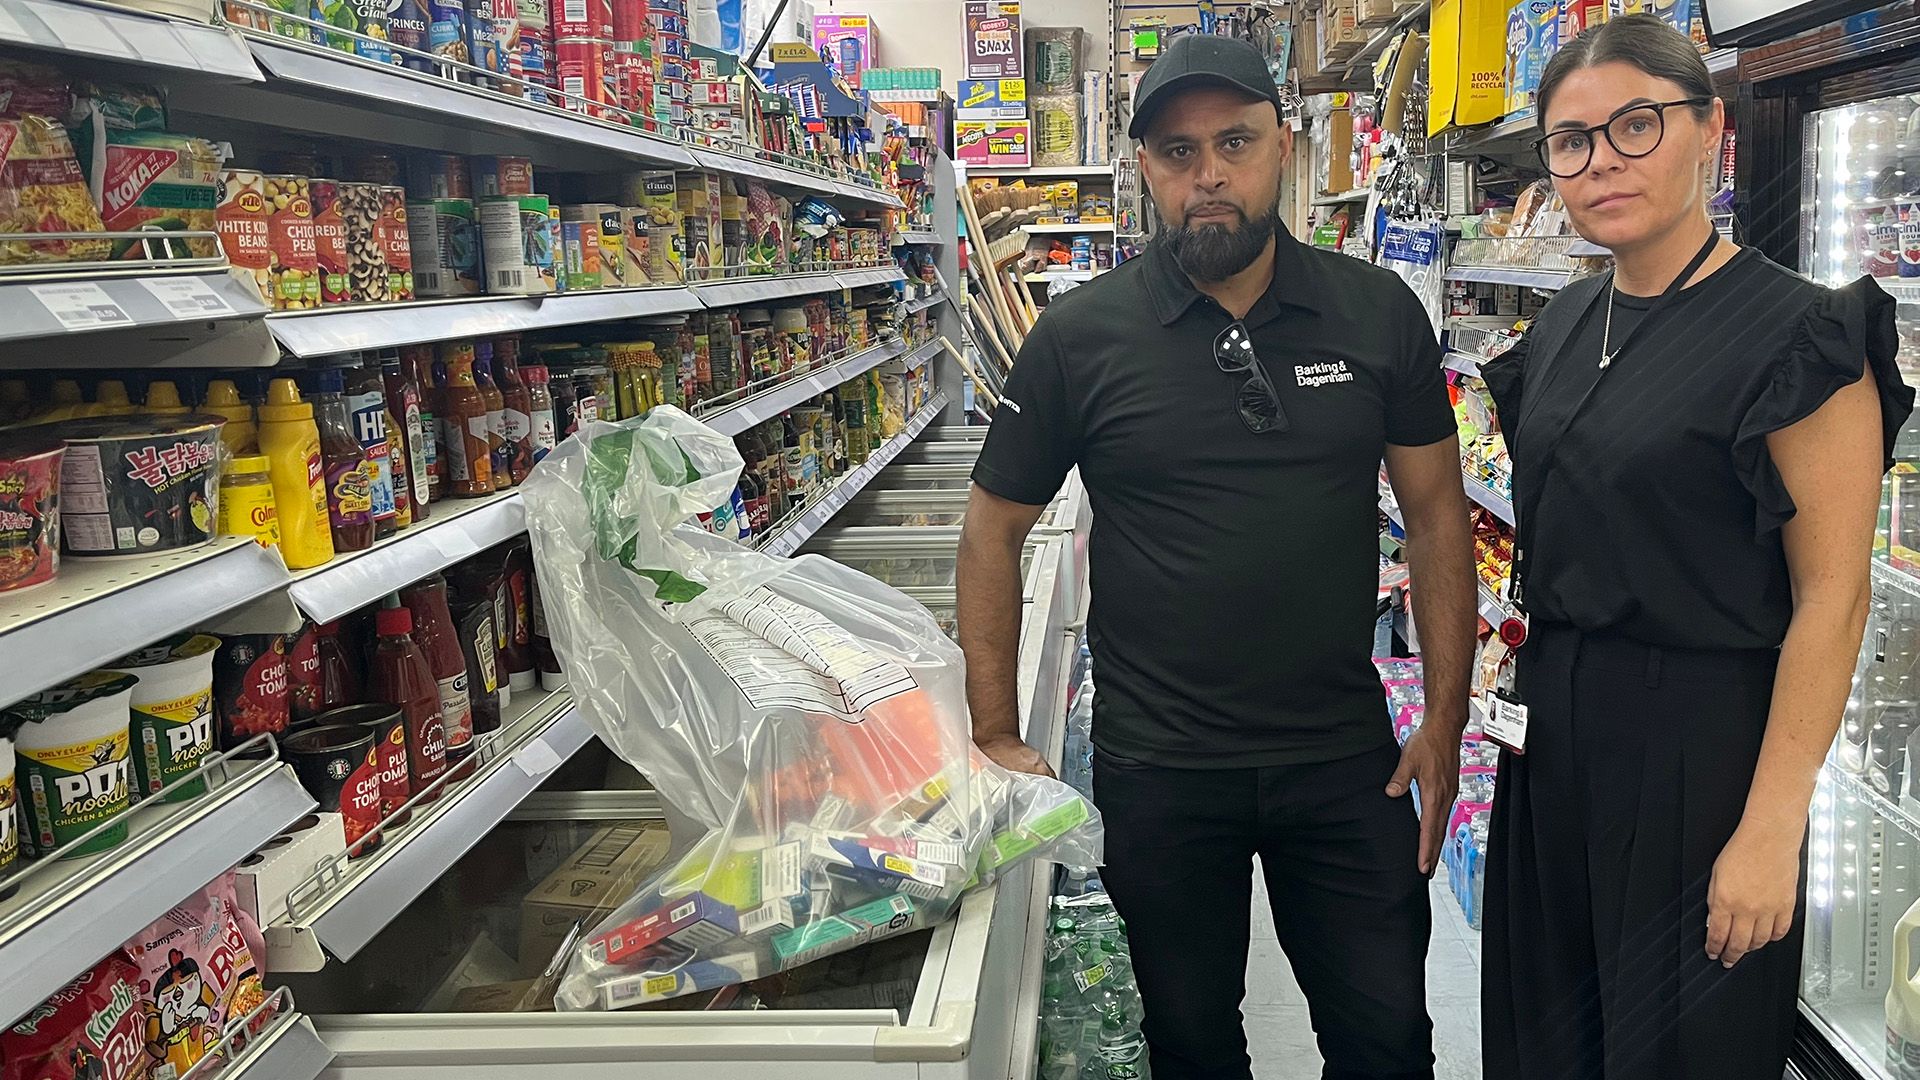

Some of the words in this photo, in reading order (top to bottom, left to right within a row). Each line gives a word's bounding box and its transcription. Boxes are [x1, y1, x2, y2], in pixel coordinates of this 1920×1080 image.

[357, 5, 388, 19] Gian
[388, 17, 425, 31] PRINCES
[977, 40, 1011, 54] SNAX
[1471, 72, 1500, 82] 100%
[989, 144, 1009, 154] WIN
[105, 162, 152, 211] KOKA
[315, 225, 337, 237] RED
[238, 235, 268, 248] BEANS
[293, 239, 316, 251] PEAS
[1412, 244, 1430, 252] LEAD
[1296, 372, 1353, 387] Dagenham
[358, 409, 386, 441] HP
[369, 445, 387, 458] SAUCE
[0, 480, 25, 494] Spicy
[153, 481, 170, 495] HOT
[151, 703, 175, 712] ONLY
[166, 712, 212, 756] PO
[37, 750, 61, 759] ONLY
[164, 761, 198, 774] CHICKEN
[421, 768, 441, 780] AWARD
[55, 813, 96, 826] CHICKEN
[145, 928, 184, 952] Samyang
[86, 978, 134, 1050] Kimchi
